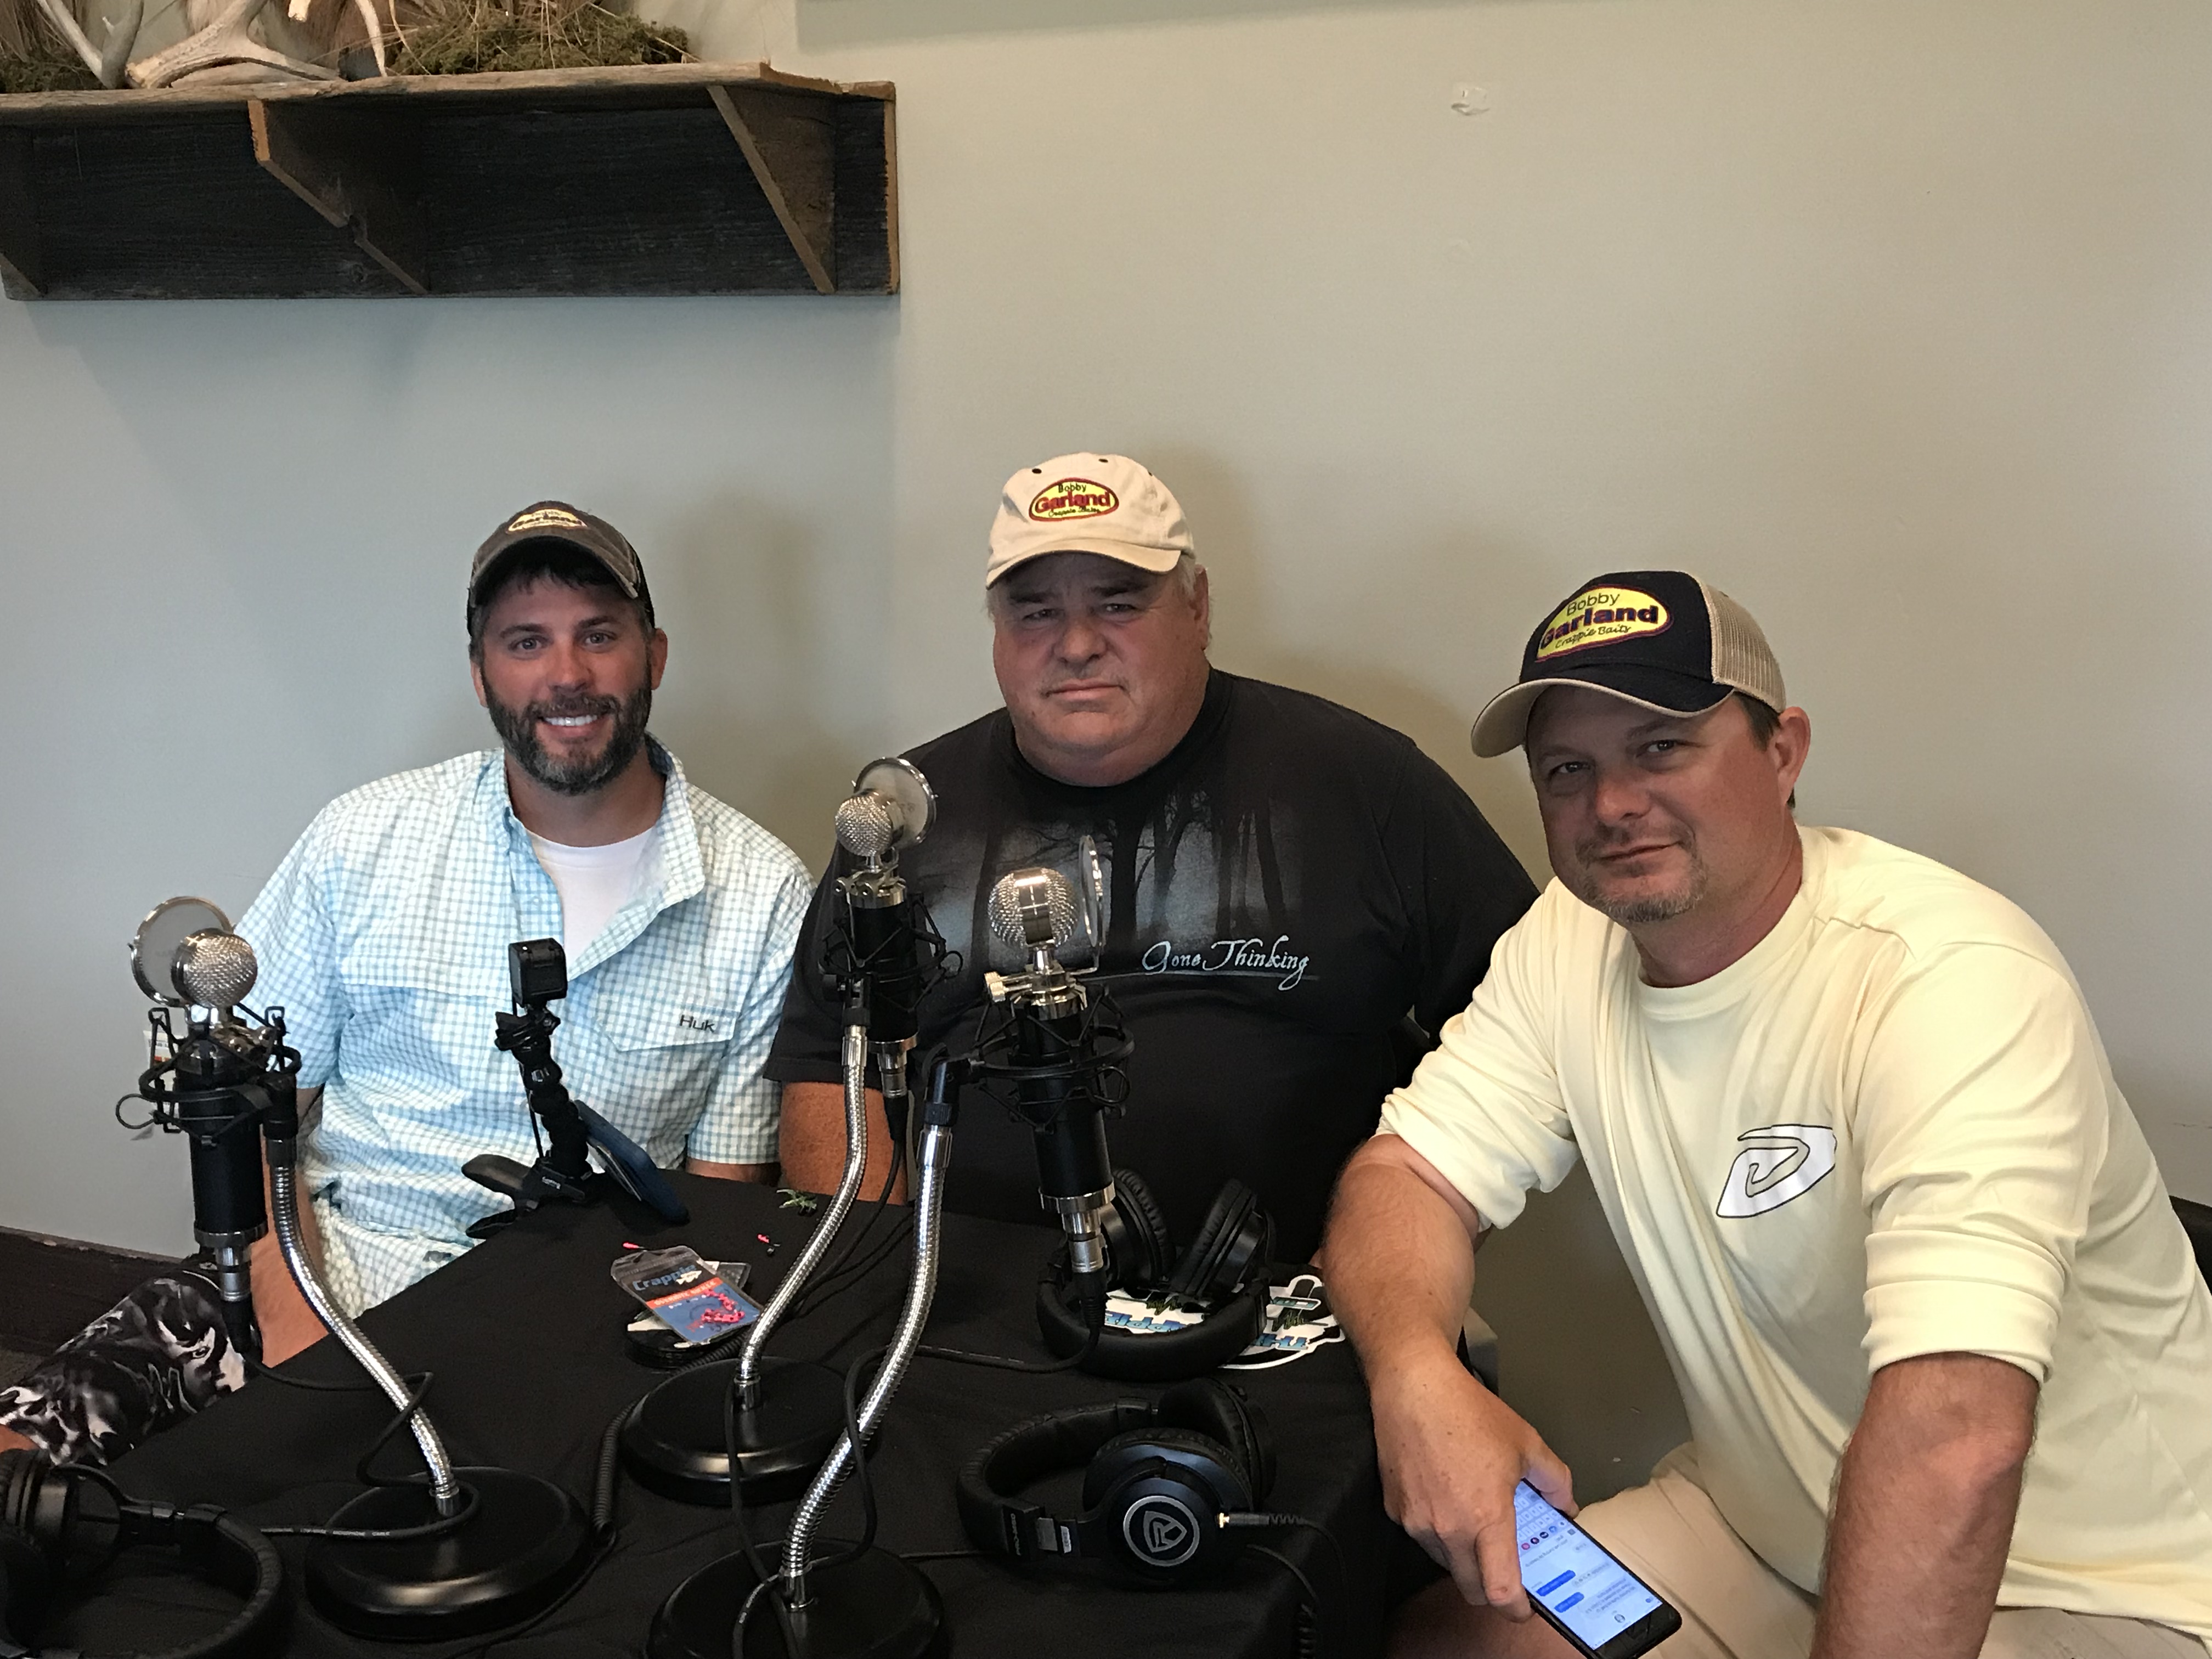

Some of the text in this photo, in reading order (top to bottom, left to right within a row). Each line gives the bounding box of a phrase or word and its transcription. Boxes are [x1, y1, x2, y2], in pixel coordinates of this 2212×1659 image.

[1058, 483, 1087, 493] Bobby
[1035, 490, 1110, 514] Garland
[1566, 592, 1620, 617] Bobby
[1541, 605, 1658, 650] Garland
[1555, 628, 1596, 648] Crappie
[1142, 935, 1310, 991] Gone Thinking
[679, 1014, 715, 1032] Huk
[632, 1264, 697, 1291] Crappie
